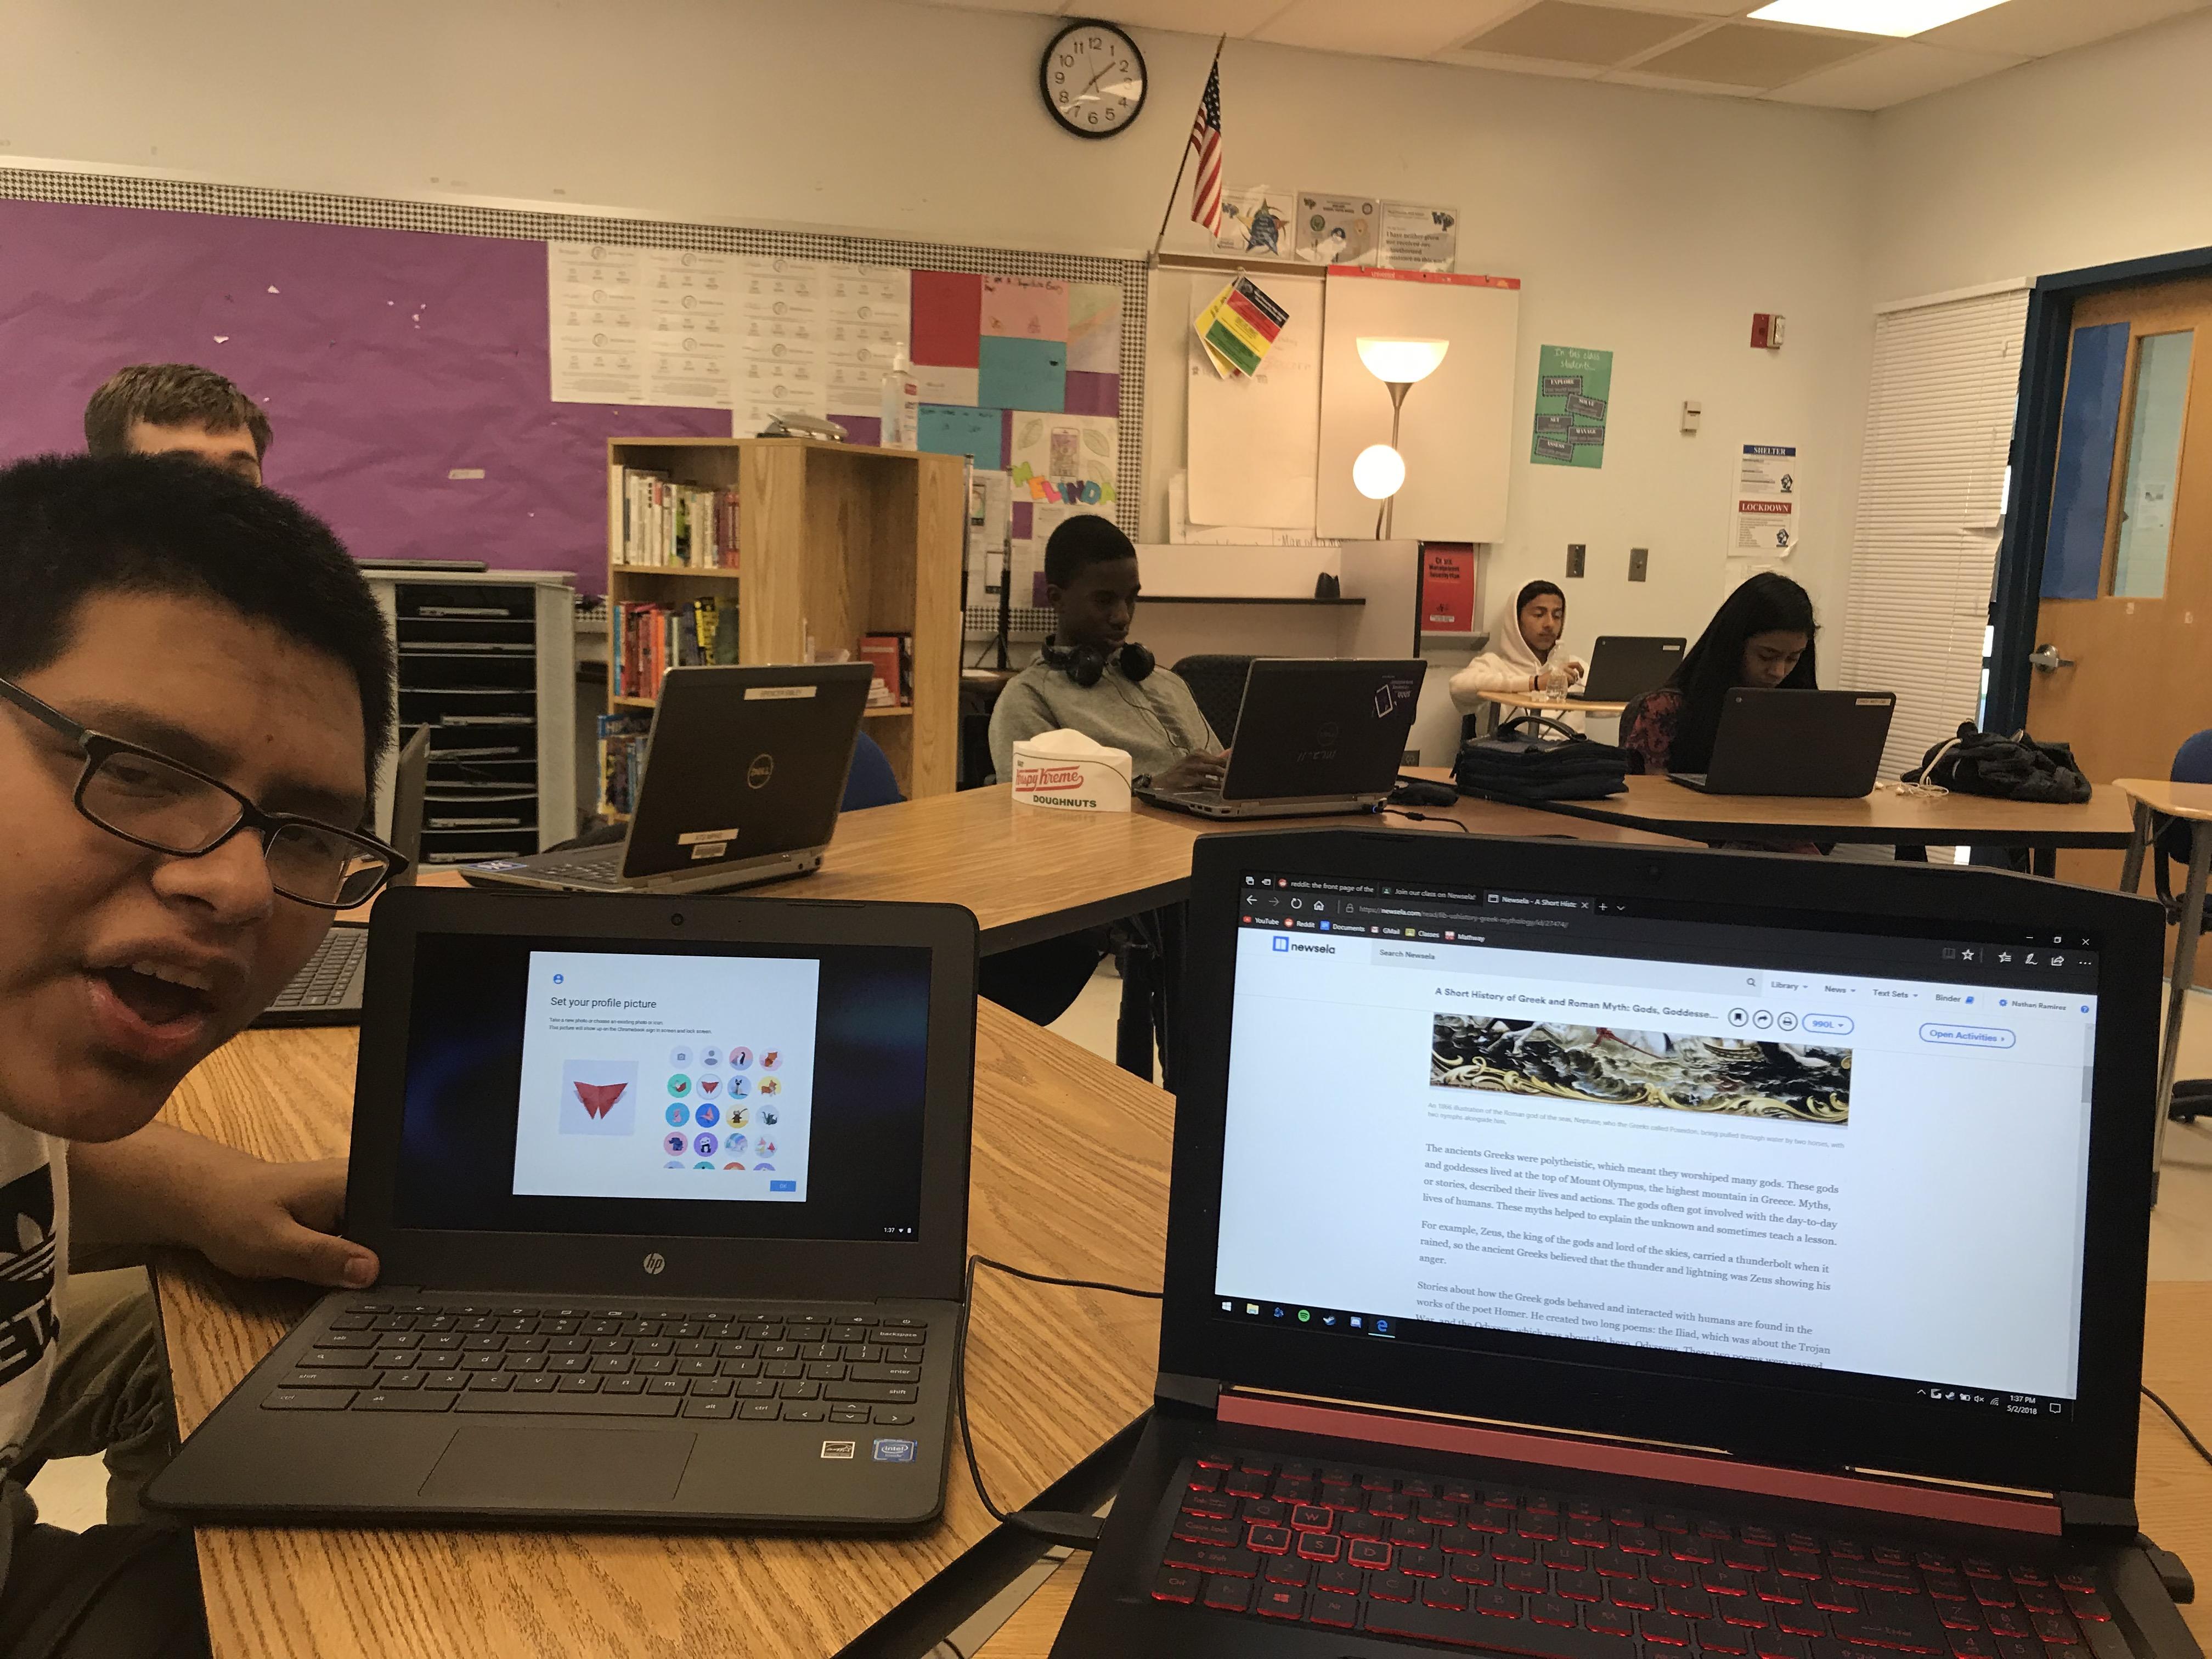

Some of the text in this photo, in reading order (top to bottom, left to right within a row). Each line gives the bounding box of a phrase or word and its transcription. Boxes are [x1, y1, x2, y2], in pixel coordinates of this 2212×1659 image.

[1074, 42, 1083, 54] 11
[1089, 37, 1102, 50] 12
[1110, 45, 1114, 57] 1
[1060, 55, 1074, 67] 10
[1120, 60, 1128, 72] 2
[1055, 72, 1065, 84] 9
[1059, 91, 1069, 103] 8
[1118, 97, 1127, 107] 4
[1074, 105, 1080, 117] 7
[1105, 108, 1115, 121] 5
[1088, 112, 1098, 124] 6
[1742, 503, 1788, 512] LOCKDOWN
[1039, 767, 1083, 787] Kreme
[1032, 795, 1097, 808] DOUGHNUTS
[1255, 917, 1279, 926] YouTube
[1333, 924, 1365, 932] Documents
[1457, 934, 1486, 943] Mathway
[1291, 944, 1335, 954] newsela
[1406, 951, 1435, 960] Newsela
[1771, 981, 1799, 991] Library
[551, 997, 656, 1009] Set your profile picture
[1445, 988, 1469, 997] Short
[1471, 990, 1504, 1001] History
[1519, 994, 1546, 1004] Greek
[1568, 998, 1600, 1008] Roman
[1602, 1002, 1629, 1011] Myth:
[1633, 1005, 1660, 1014] Gods,
[1936, 994, 1961, 1002] Binder
[1930, 1029, 1997, 1041] Open Activities
[1425, 1143, 1443, 1153] The
[1444, 1147, 1481, 1156] ancients
[1483, 1149, 1515, 1160] Greeks
[1598, 1161, 1625, 1172] which
[1627, 1166, 1656, 1175] meant
[1659, 1167, 1679, 1179] they
[1681, 1172, 1729, 1183] worshiped
[1731, 1177, 1758, 1187] many
[1786, 1180, 1815, 1190] These
[1816, 1184, 1839, 1194] gods
[1424, 1160, 1442, 1169] and
[1443, 1163, 1488, 1174] goddesses
[1490, 1166, 1512, 1177] lived
[1525, 1170, 1539, 1180] the
[1542, 1173, 1557, 1183] top
[1558, 1175, 1569, 1183] of
[1570, 1175, 1601, 1186] Mount
[1649, 1183, 1664, 1193] the
[1666, 1185, 1700, 1197] highest
[1702, 1191, 1747, 1201] mountain
[1749, 1193, 1759, 1203] in
[1417, 1299, 1443, 1308] works
[1445, 1301, 1455, 1310] of
[1456, 1302, 1470, 1311] the
[1472, 1306, 1492, 1314] poet
[1531, 1311, 1544, 1320] He
[1546, 1315, 1579, 1324] created
[1581, 1318, 1599, 1327] two
[1600, 1319, 1621, 1331] long
[1658, 1326, 1673, 1335] the
[1702, 1331, 1729, 1342] which
[1751, 1337, 1779, 1347] about
[1781, 1340, 1796, 1350] the
[1798, 1342, 1830, 1355] Trojan
[2007, 1404, 2037, 1415] 5/2/2018
[1306, 1512, 1319, 1521] W
[1265, 1533, 1274, 1542] A
[1316, 1540, 1324, 1549] S
[1364, 1548, 1375, 1556] D
